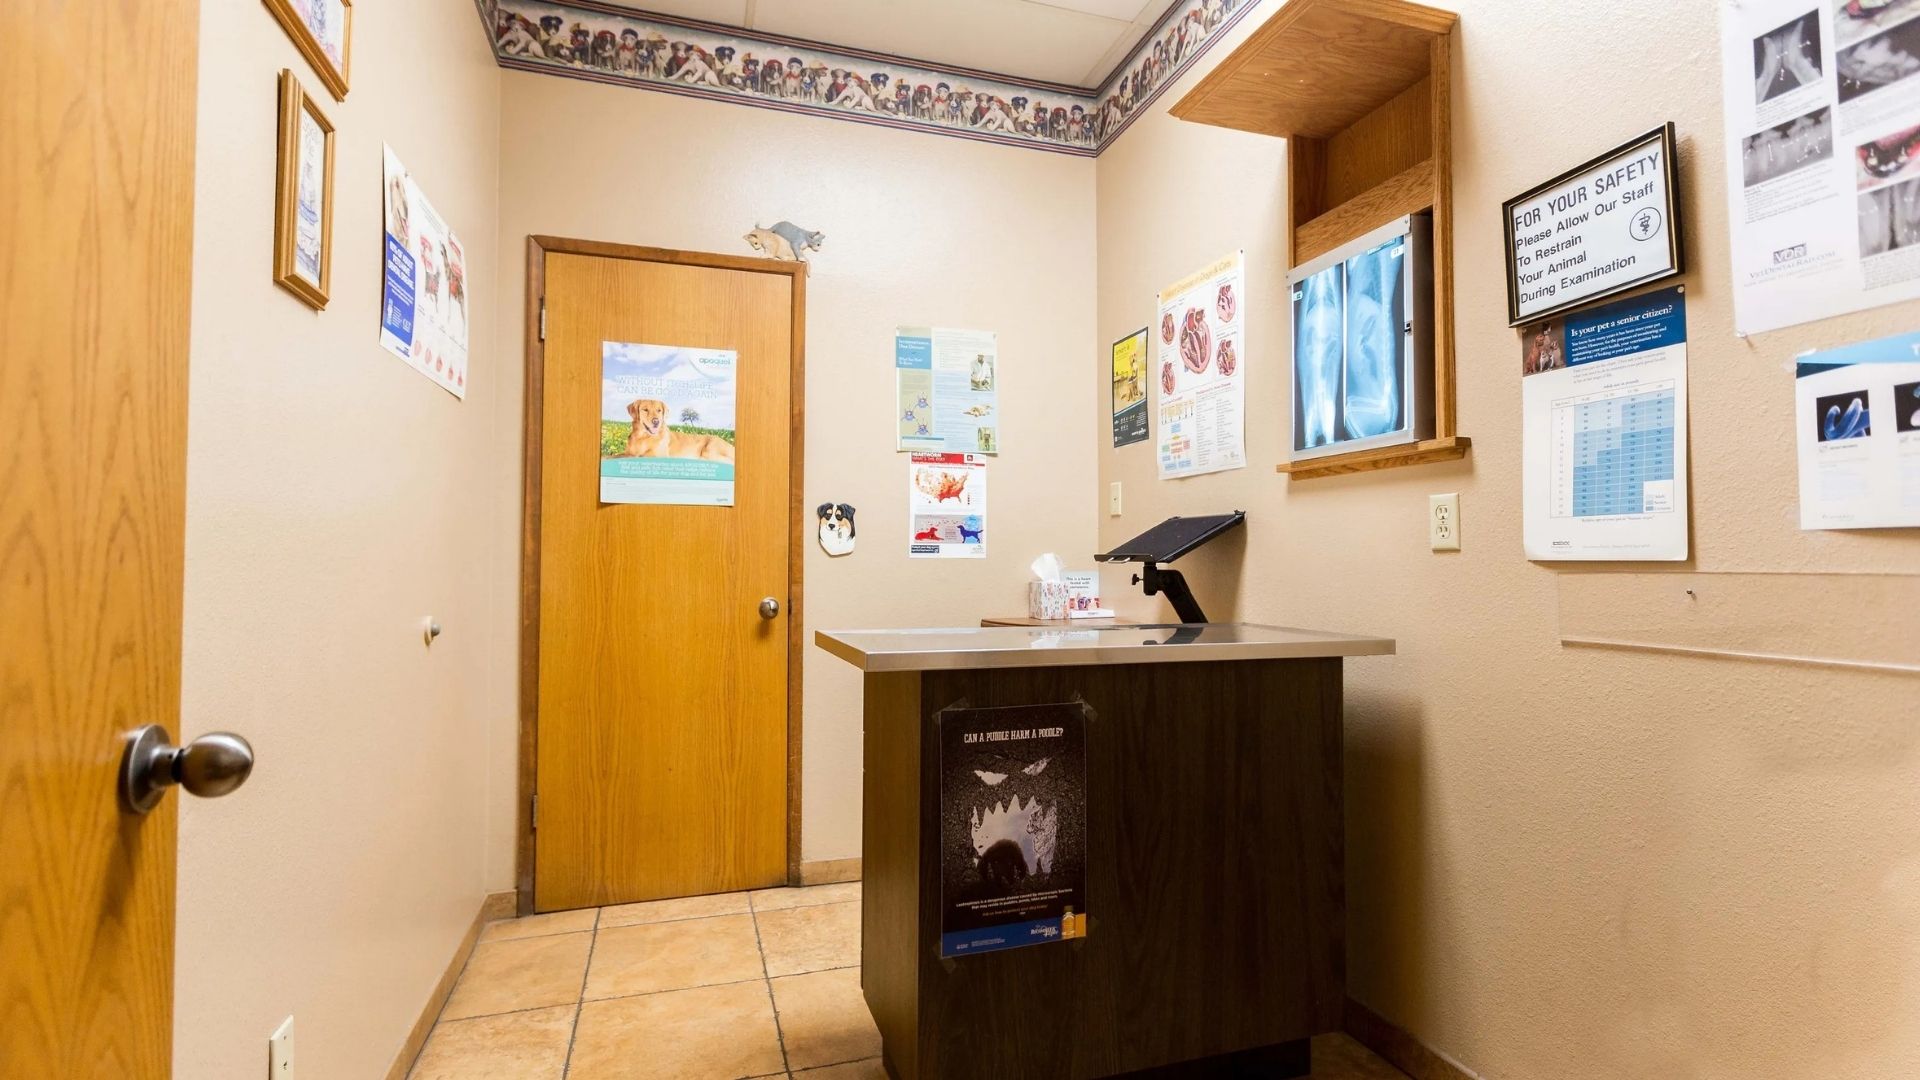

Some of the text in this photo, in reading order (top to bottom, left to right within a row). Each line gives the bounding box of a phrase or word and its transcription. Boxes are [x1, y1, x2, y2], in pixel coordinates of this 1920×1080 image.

[1515, 152, 1659, 231] FOR YOUR SAFETY
[1517, 181, 1654, 250] Please Allow Our Staff
[1517, 234, 1582, 268] To Restrain
[1519, 250, 1587, 286] Your Animal
[1521, 254, 1636, 304] During Examination
[1579, 325, 1596, 337] your
[1597, 322, 1609, 333] pet
[1617, 314, 1641, 326] senior
[1642, 305, 1672, 319] citizen?
[617, 387, 638, 395] CAN
[964, 728, 1064, 743] CAN A PUDDLE HARM A POODLE?
